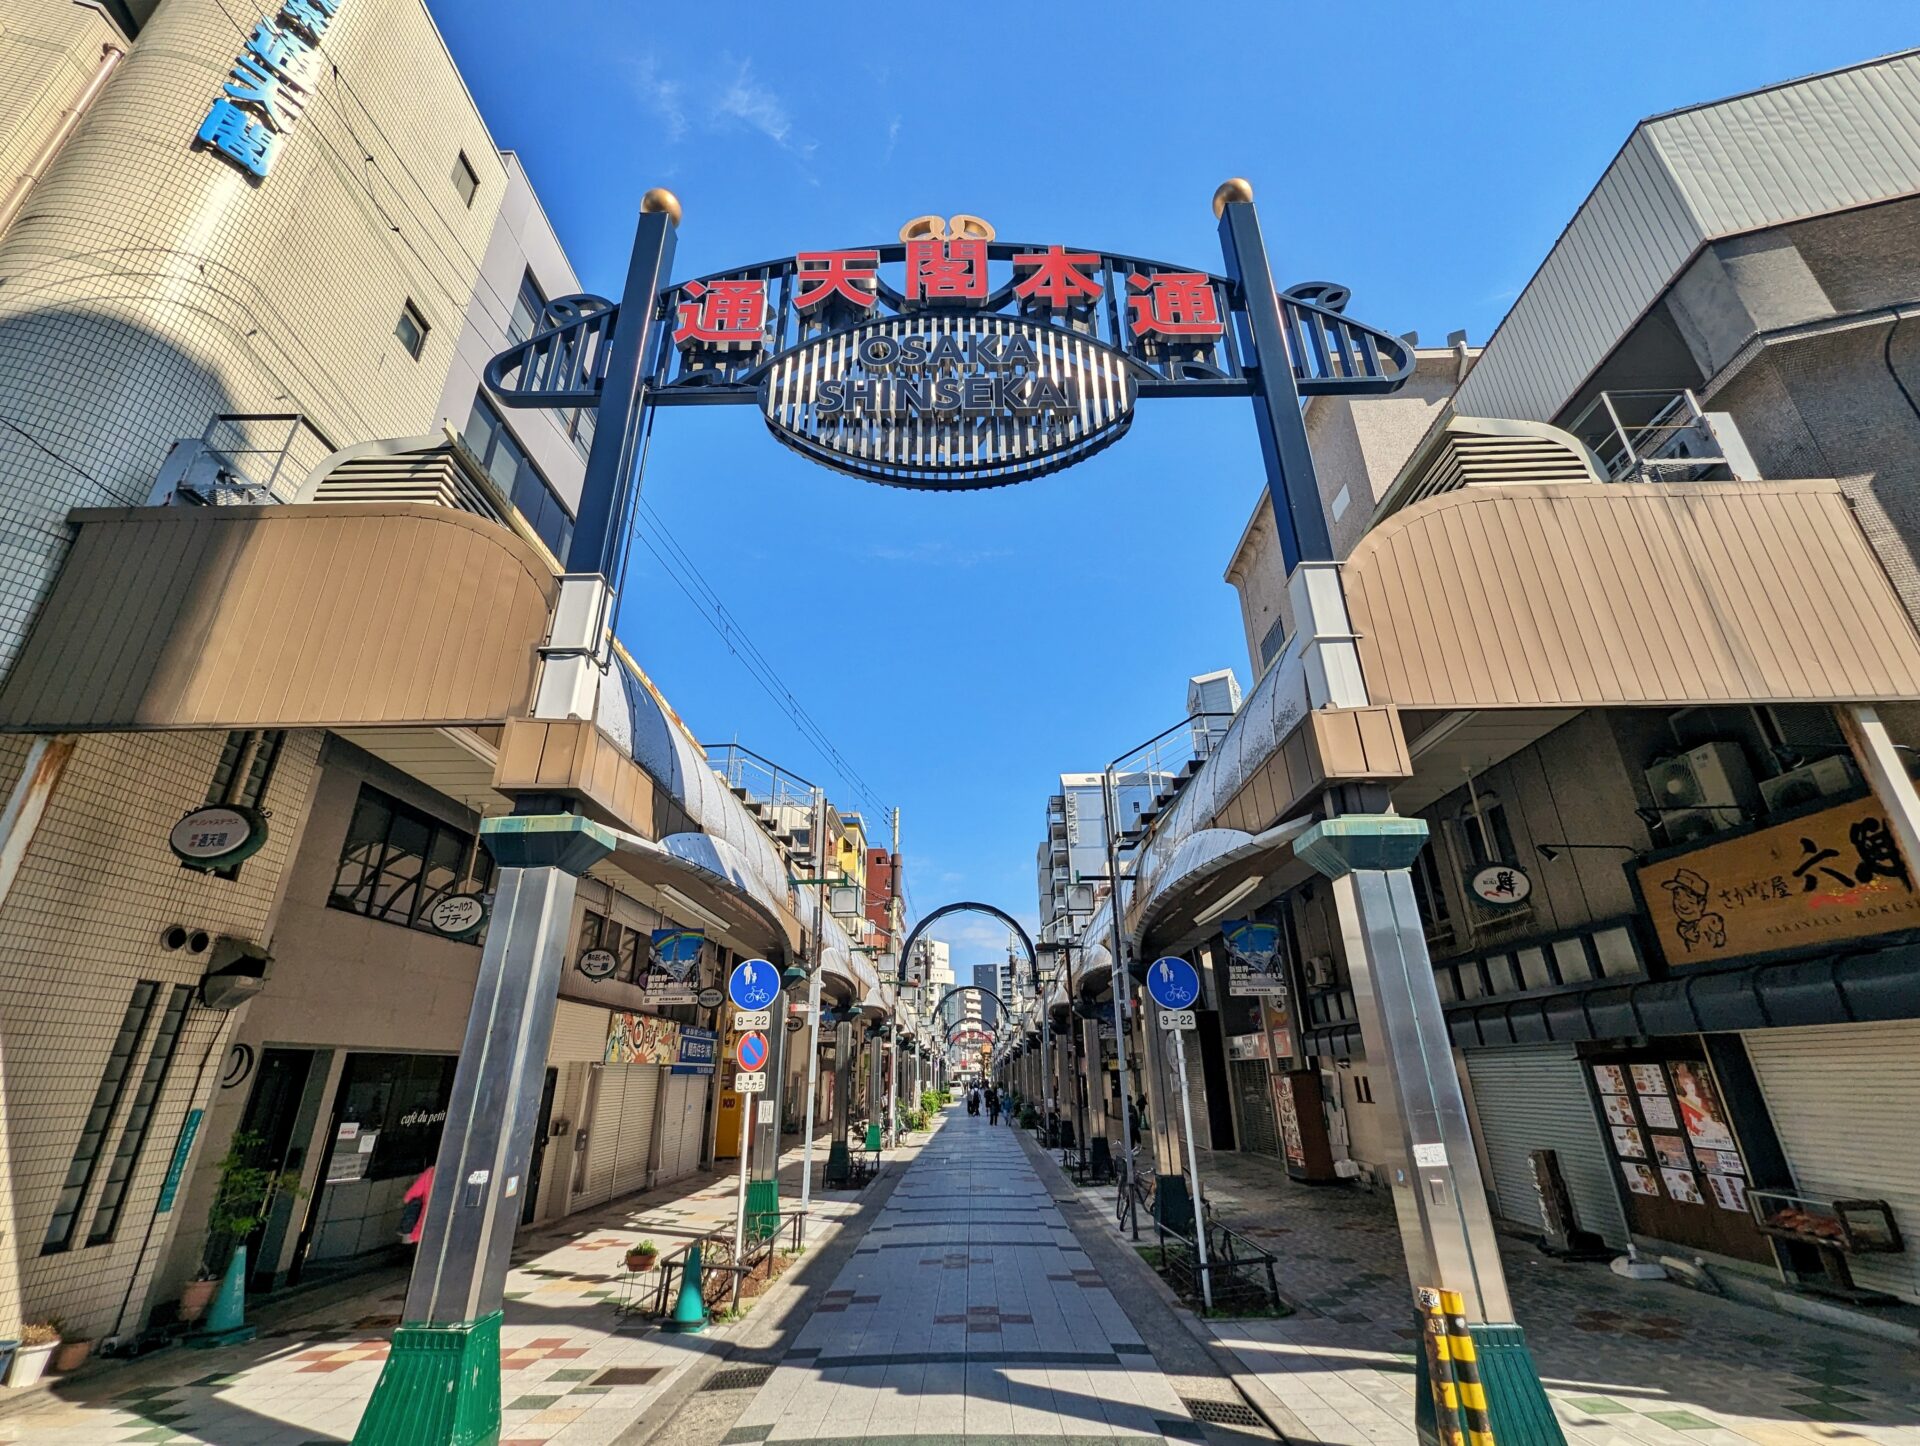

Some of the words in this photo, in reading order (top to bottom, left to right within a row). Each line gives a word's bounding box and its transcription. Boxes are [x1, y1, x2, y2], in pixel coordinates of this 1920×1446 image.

[674, 239, 1225, 346] 通天閣本通
[859, 334, 1039, 368] OSAKA
[816, 376, 1080, 413] SHINSEKAI
[440, 901, 473, 912] コーヒーハウス
[736, 1081, 764, 1091] ここから
